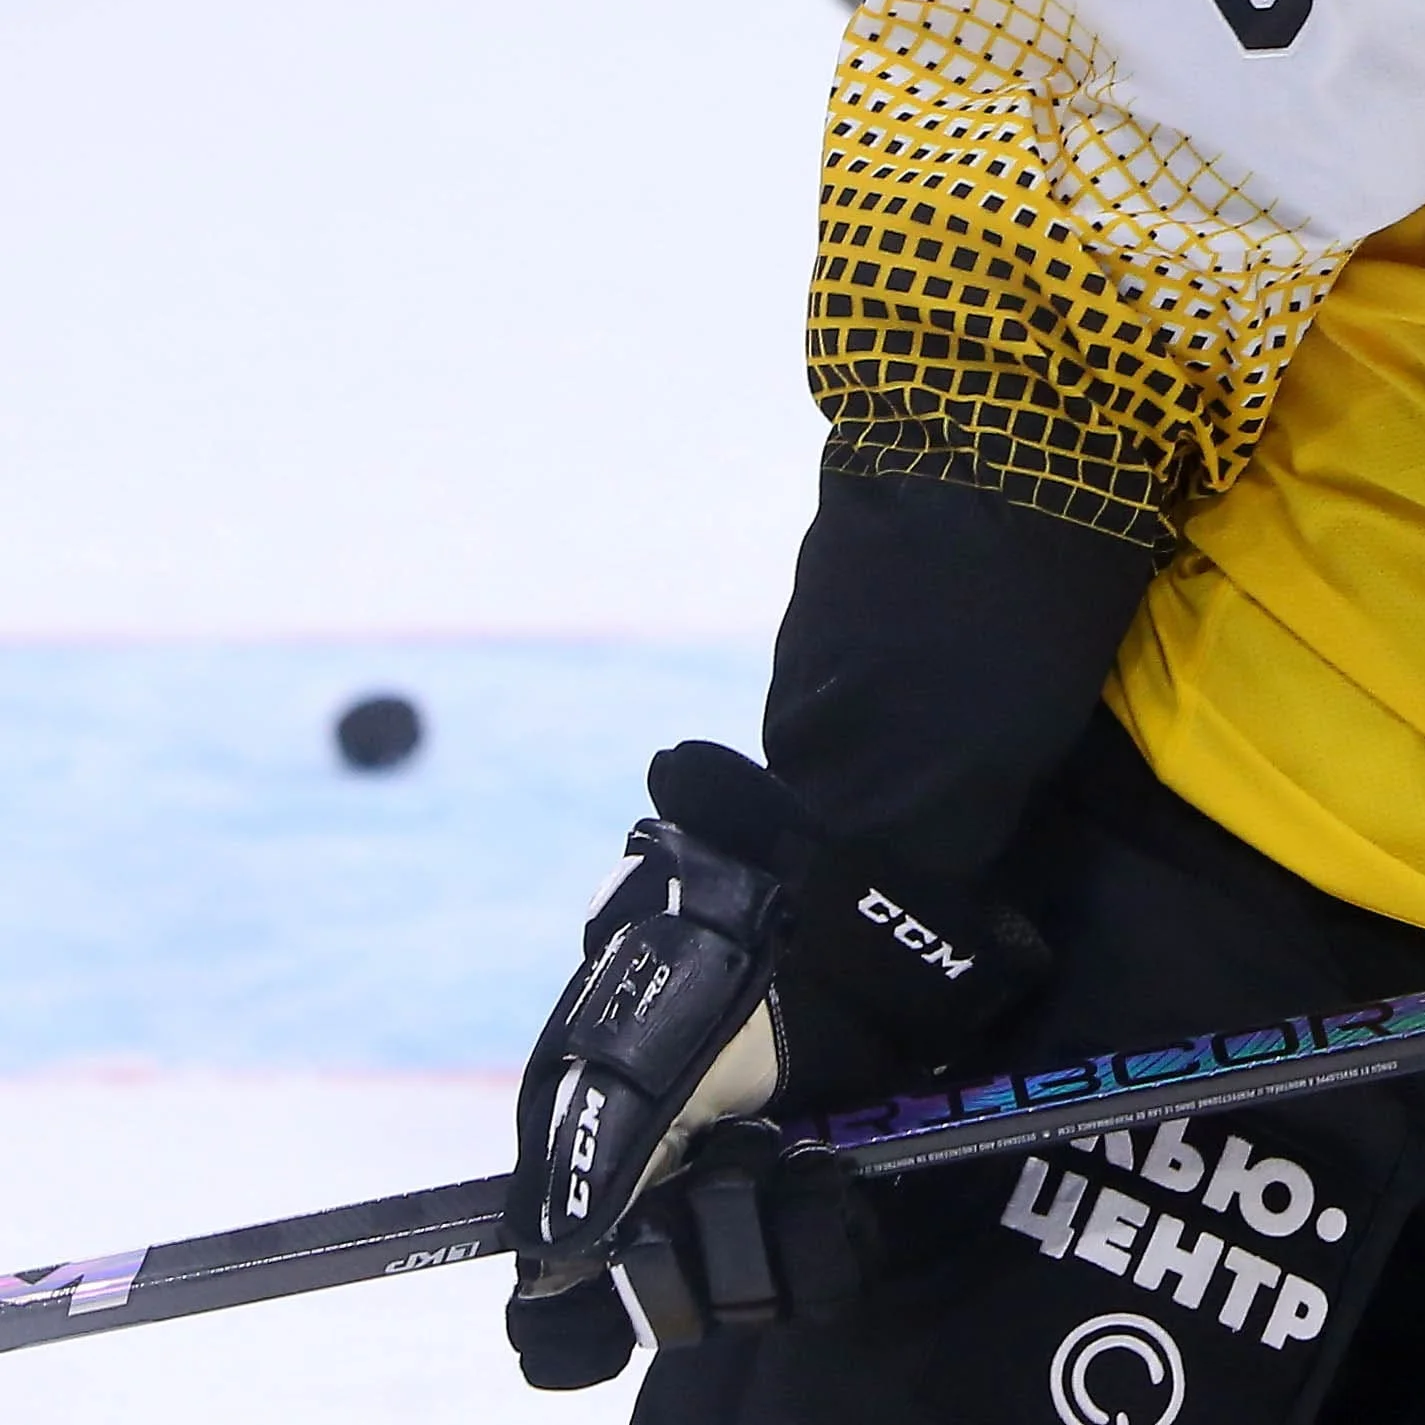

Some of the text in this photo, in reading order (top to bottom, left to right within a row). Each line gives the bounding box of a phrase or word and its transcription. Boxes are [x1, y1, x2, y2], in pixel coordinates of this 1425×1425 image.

[857, 887, 976, 980] CCM
[566, 1087, 606, 1219] CCM
[1000, 1155, 1330, 1351] ЦЕНТР
